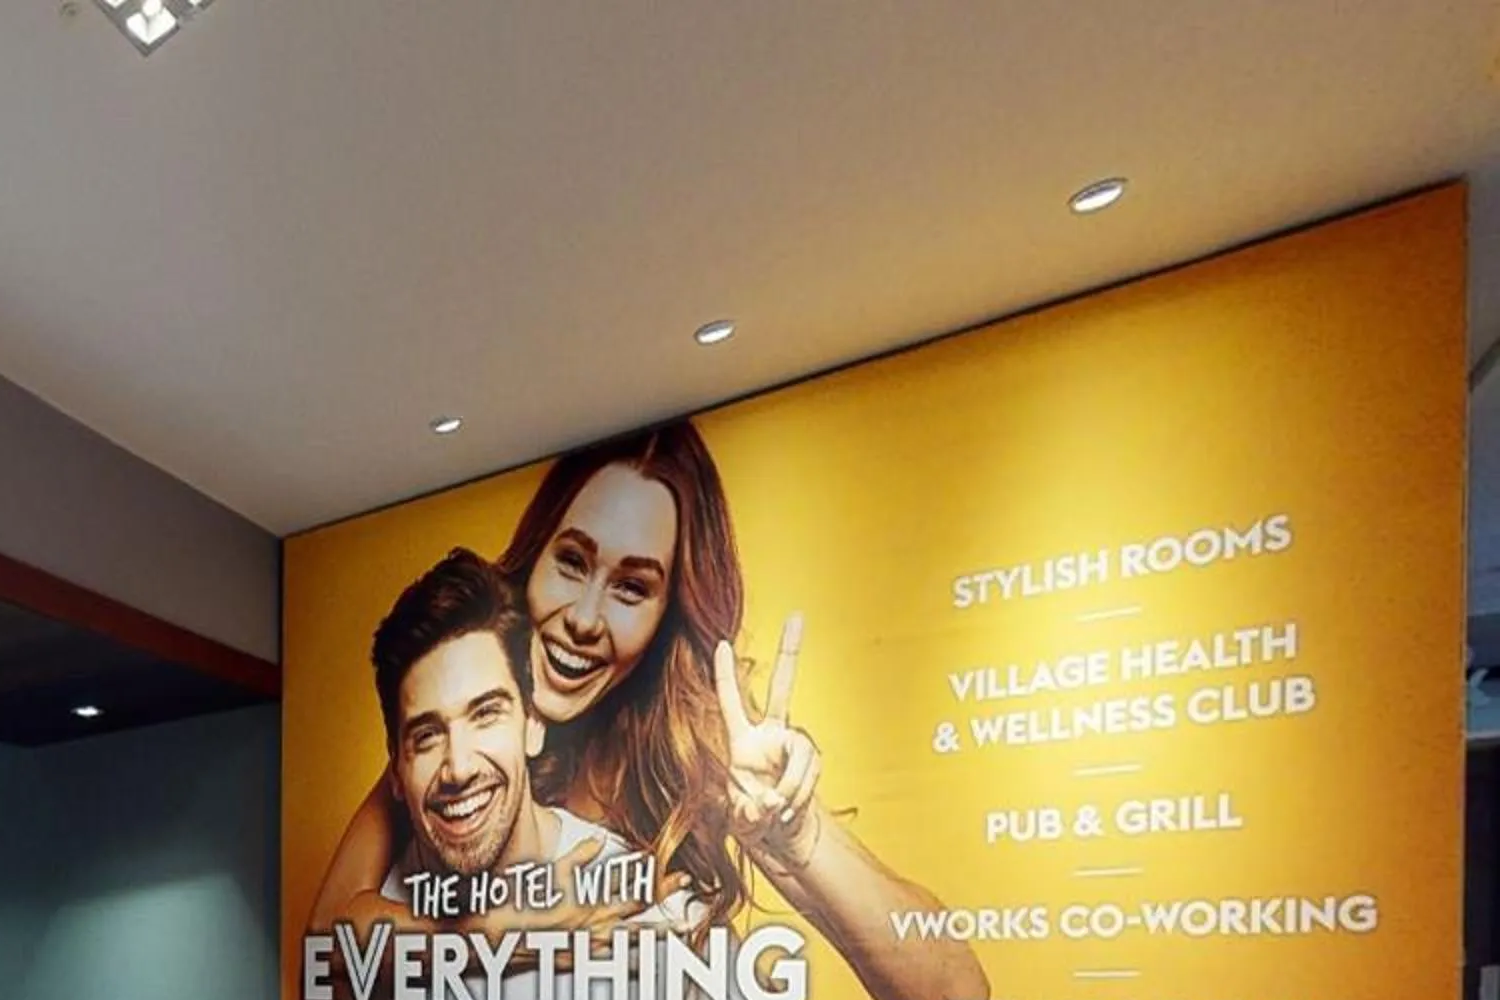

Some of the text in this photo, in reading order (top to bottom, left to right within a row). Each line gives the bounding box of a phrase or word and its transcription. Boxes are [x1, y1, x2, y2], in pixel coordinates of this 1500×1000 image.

[953, 515, 1292, 607] STYLISH ROOMS
[949, 623, 1296, 702] VILLAGE HEALTH
[933, 677, 1315, 752] & WELLNESS CLUB
[987, 794, 1242, 842] PUB & GRILL
[404, 855, 656, 918] THE HOTEL WITH
[890, 895, 1378, 941] VWORKS CO-WORKING
